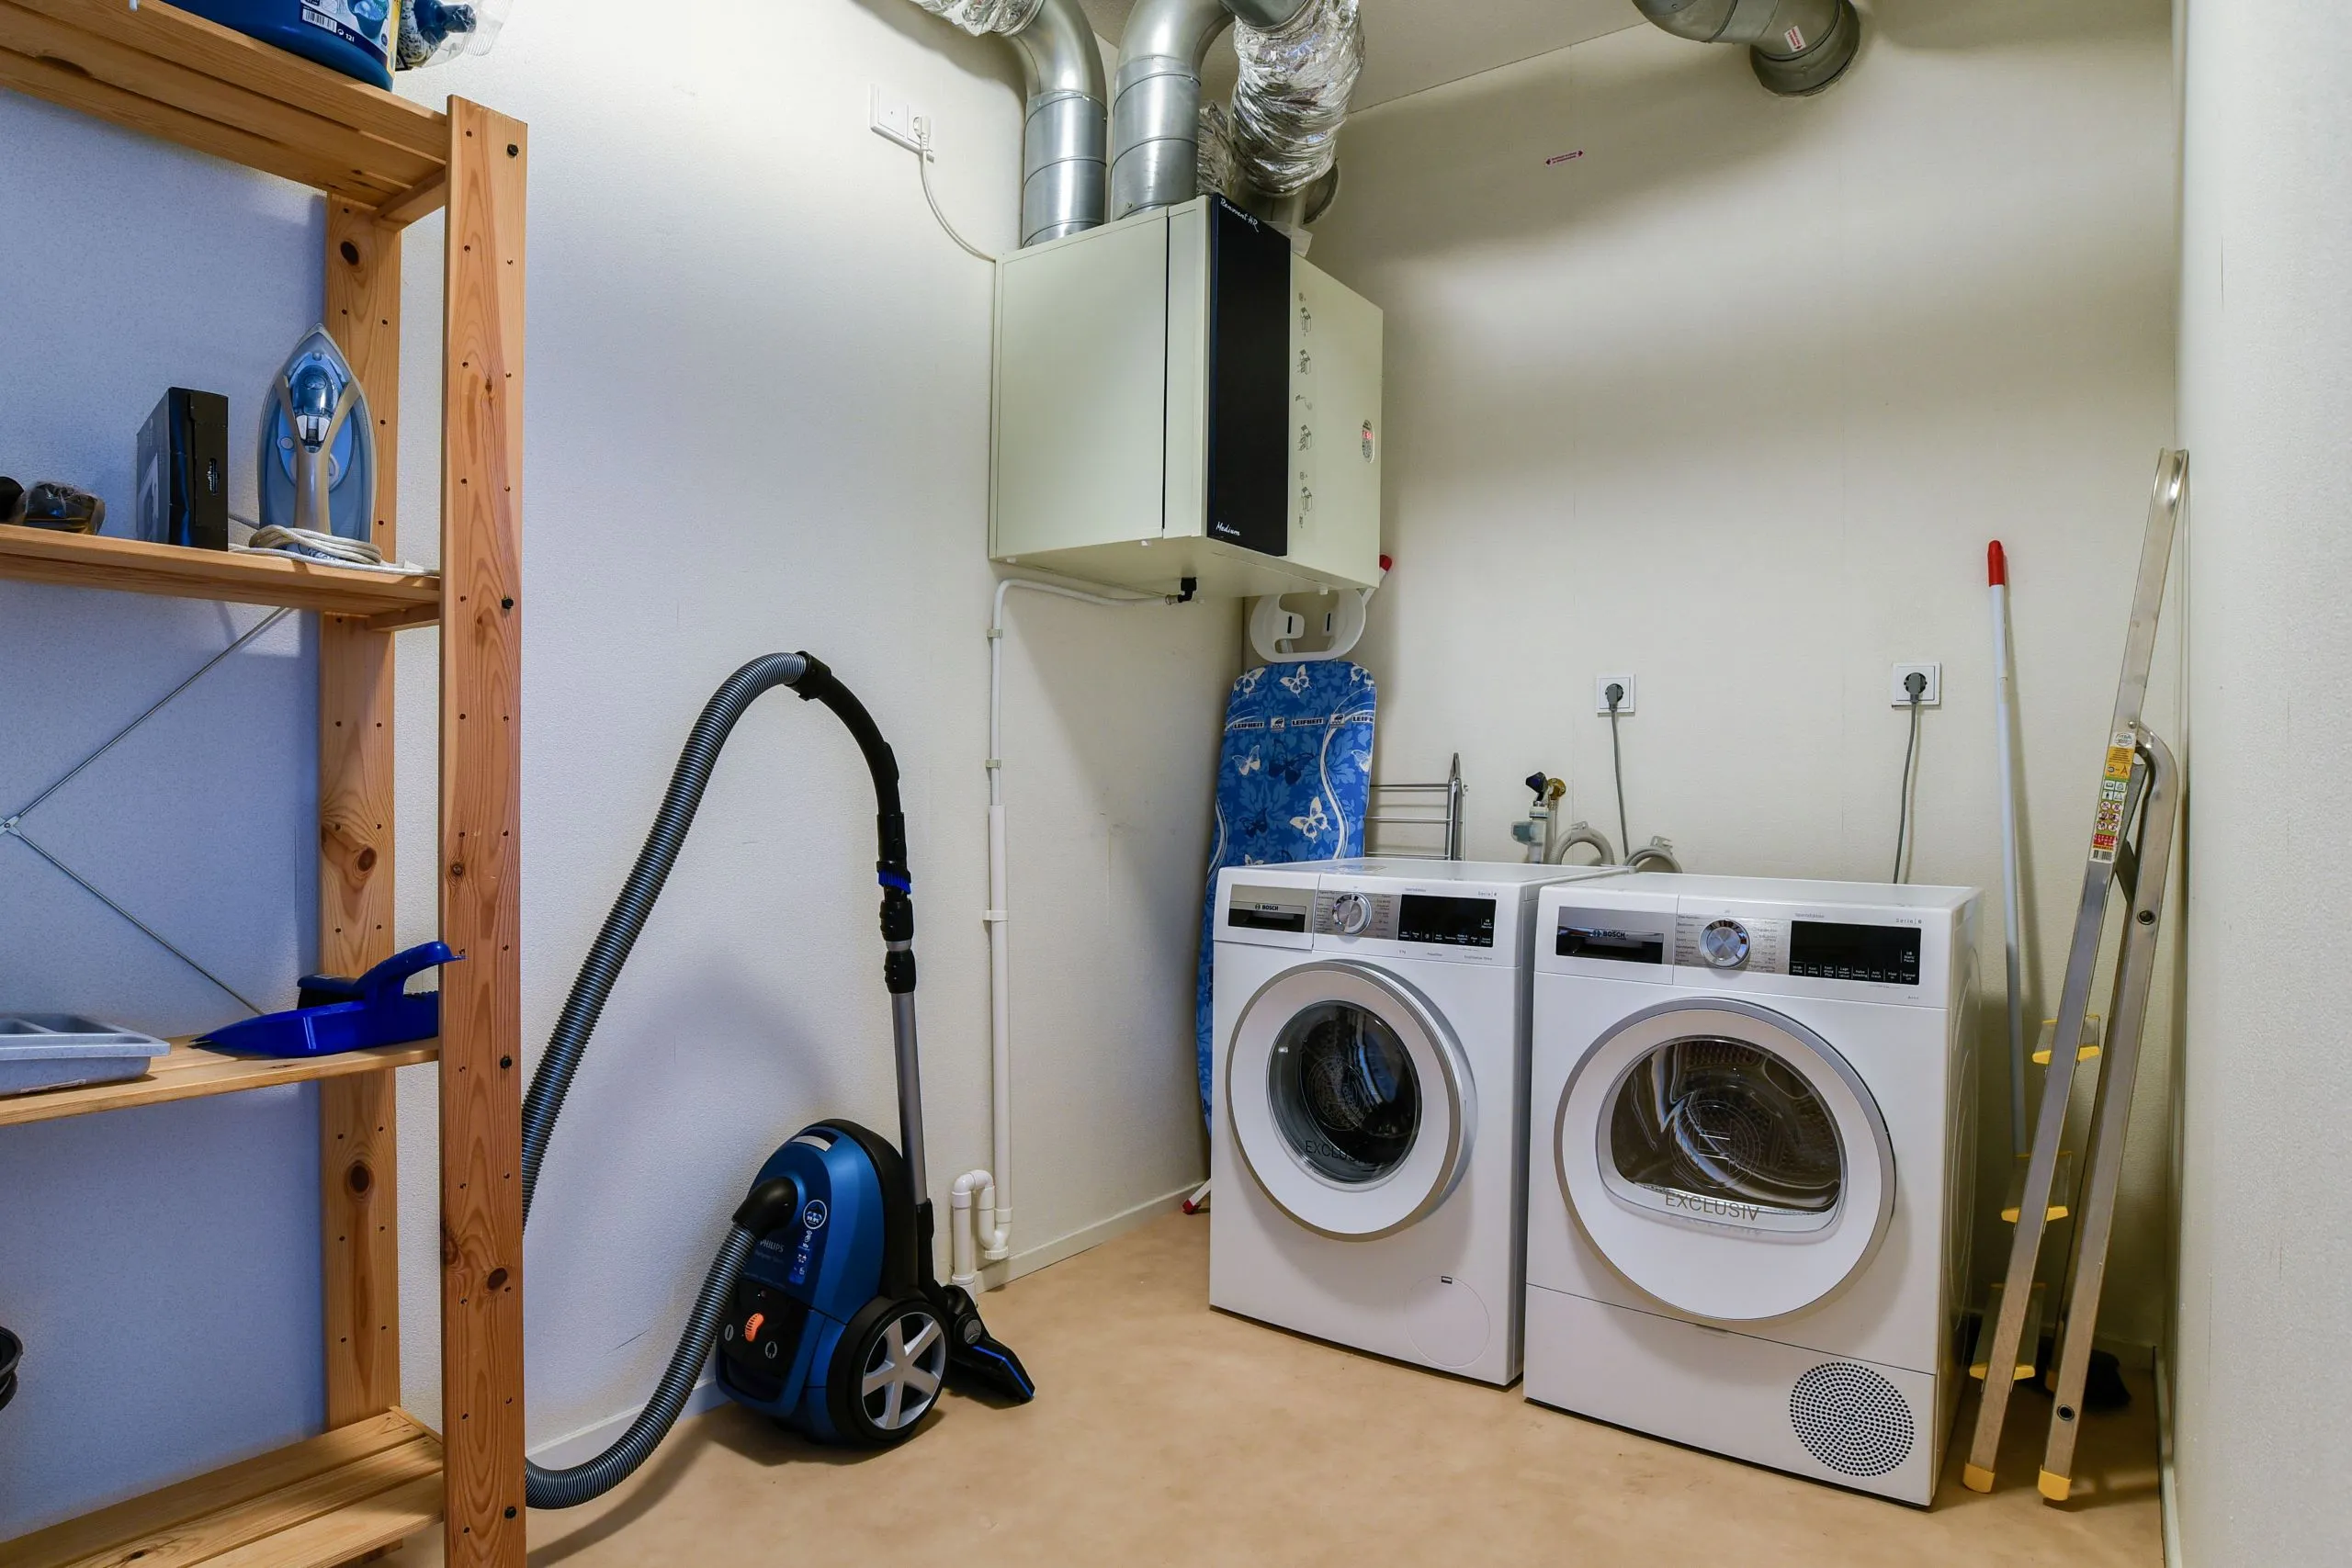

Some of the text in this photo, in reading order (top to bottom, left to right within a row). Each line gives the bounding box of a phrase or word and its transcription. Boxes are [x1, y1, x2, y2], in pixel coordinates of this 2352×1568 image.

[1220, 197, 1249, 221] Renovent
[1216, 521, 1240, 536] Medium
[1664, 1191, 1760, 1222] EXCLUSIV
[759, 1239, 785, 1253] PHILIPS
